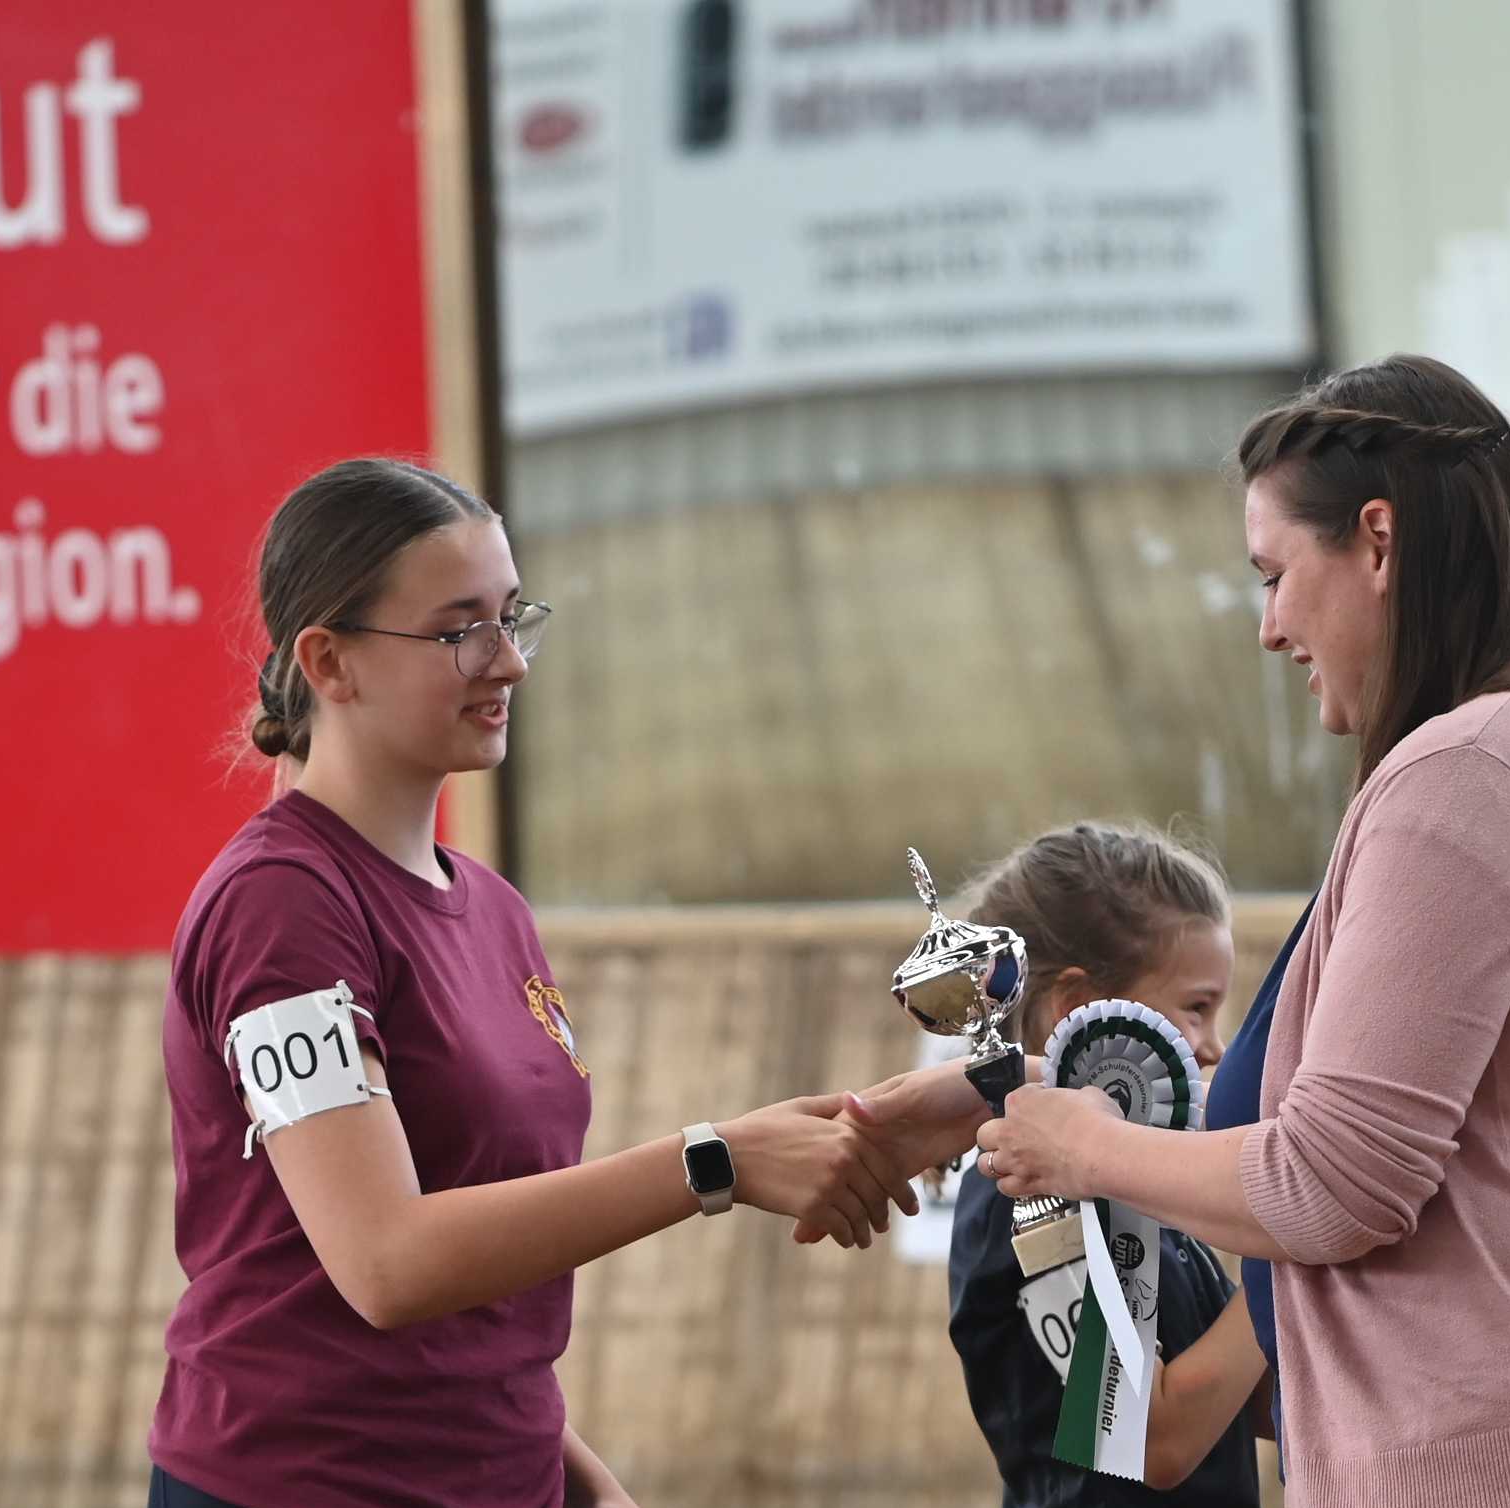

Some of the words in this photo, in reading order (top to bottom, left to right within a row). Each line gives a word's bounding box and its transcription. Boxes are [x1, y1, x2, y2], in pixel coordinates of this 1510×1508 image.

[11, 323, 165, 456] die
[251, 1022, 349, 1093] 001
[1089, 1062, 1148, 1115] M-Schulpferdeturnier
[1101, 1348, 1124, 1436] deturnier
